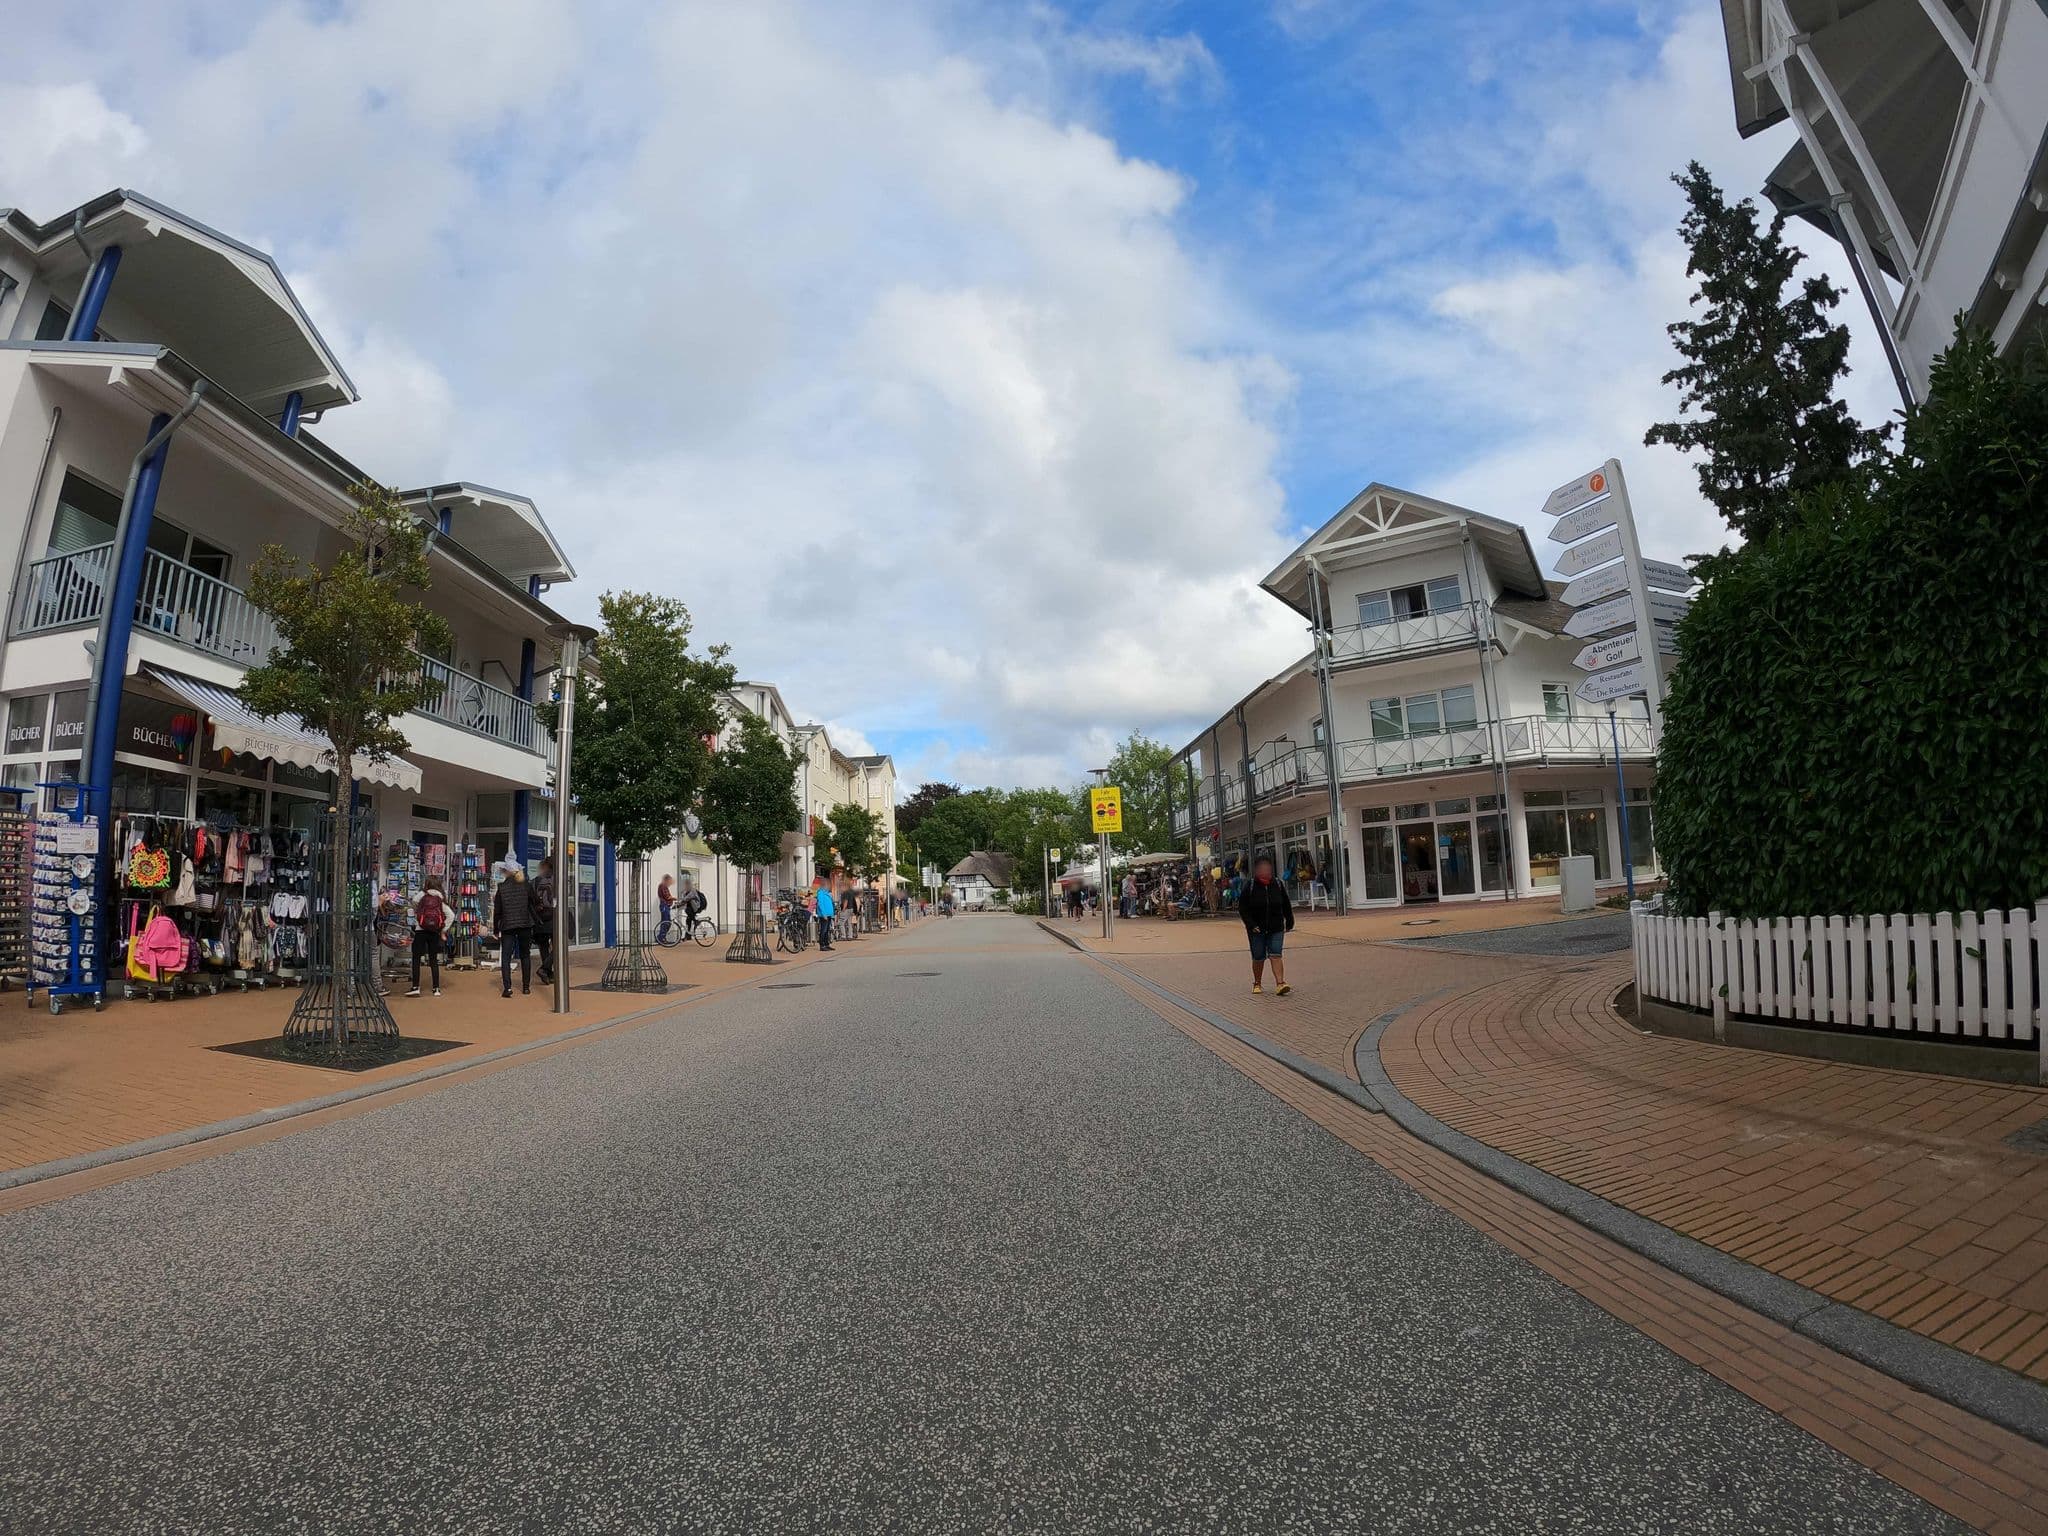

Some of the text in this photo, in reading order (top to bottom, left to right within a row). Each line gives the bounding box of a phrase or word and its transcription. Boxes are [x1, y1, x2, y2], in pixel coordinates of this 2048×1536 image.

[1582, 504, 1602, 519] Hotel
[1592, 635, 1634, 654] Abenteuer
[1605, 650, 1624, 662] Golf
[1599, 669, 1633, 683] Restaurant
[1596, 682, 1640, 698] Die Räucherei
[10, 726, 41, 741] BÜCHER
[56, 722, 84, 737] BÜCHE
[132, 726, 177, 749] BÜCHER
[244, 737, 280, 755] BÜCHER
[375, 767, 401, 781] BÜCHER
